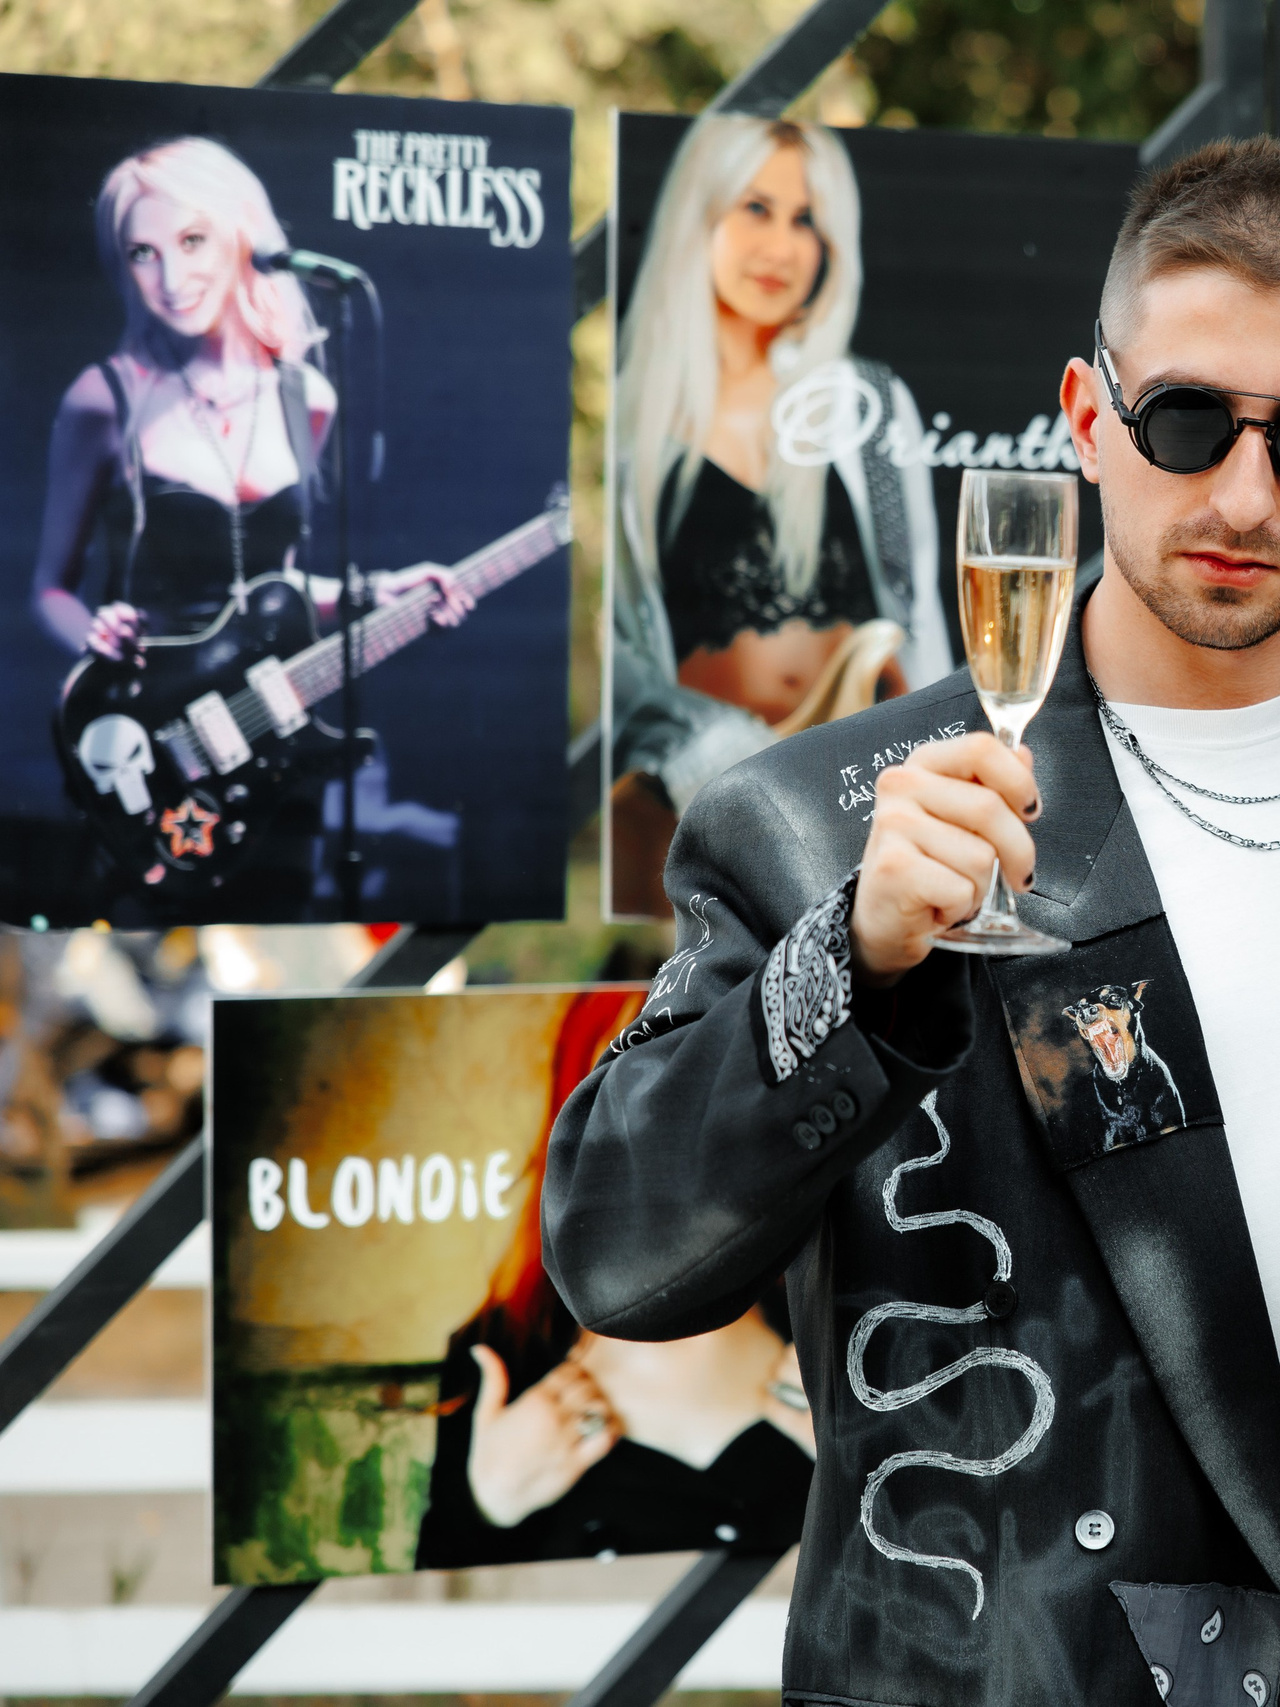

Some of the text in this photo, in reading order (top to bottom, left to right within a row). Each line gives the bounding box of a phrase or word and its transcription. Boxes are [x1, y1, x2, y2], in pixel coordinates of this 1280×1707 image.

[353, 128, 490, 171] THE PRETTY
[333, 157, 544, 249] RECKLESS
[771, 357, 1082, 470] Orianth
[839, 764, 863, 786] IF
